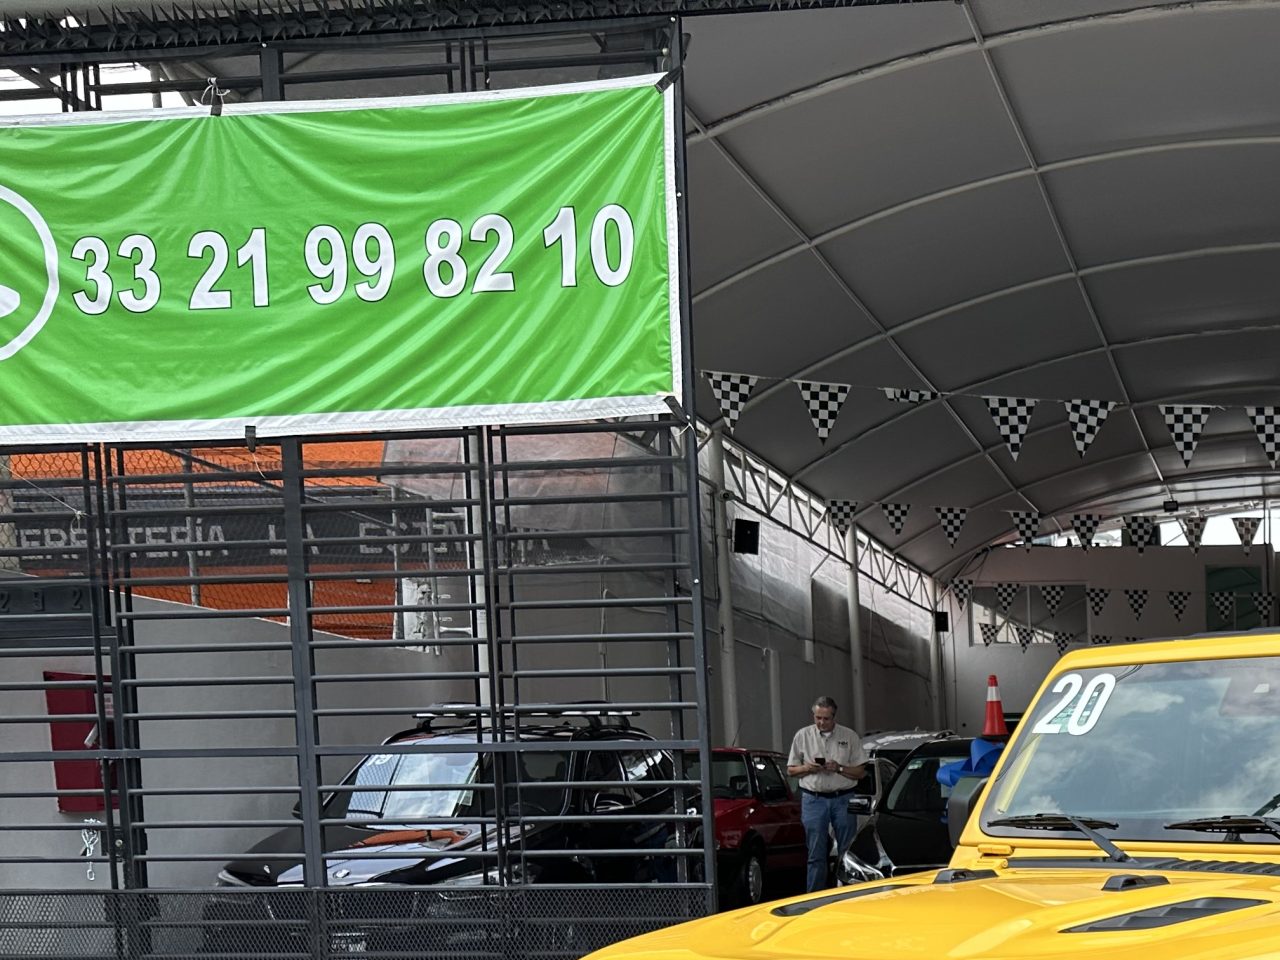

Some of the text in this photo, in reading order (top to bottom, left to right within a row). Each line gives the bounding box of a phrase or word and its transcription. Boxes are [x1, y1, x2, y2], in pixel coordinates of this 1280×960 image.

[70, 203, 635, 315] 33 21 99 82 10
[1032, 673, 1116, 735] 20
